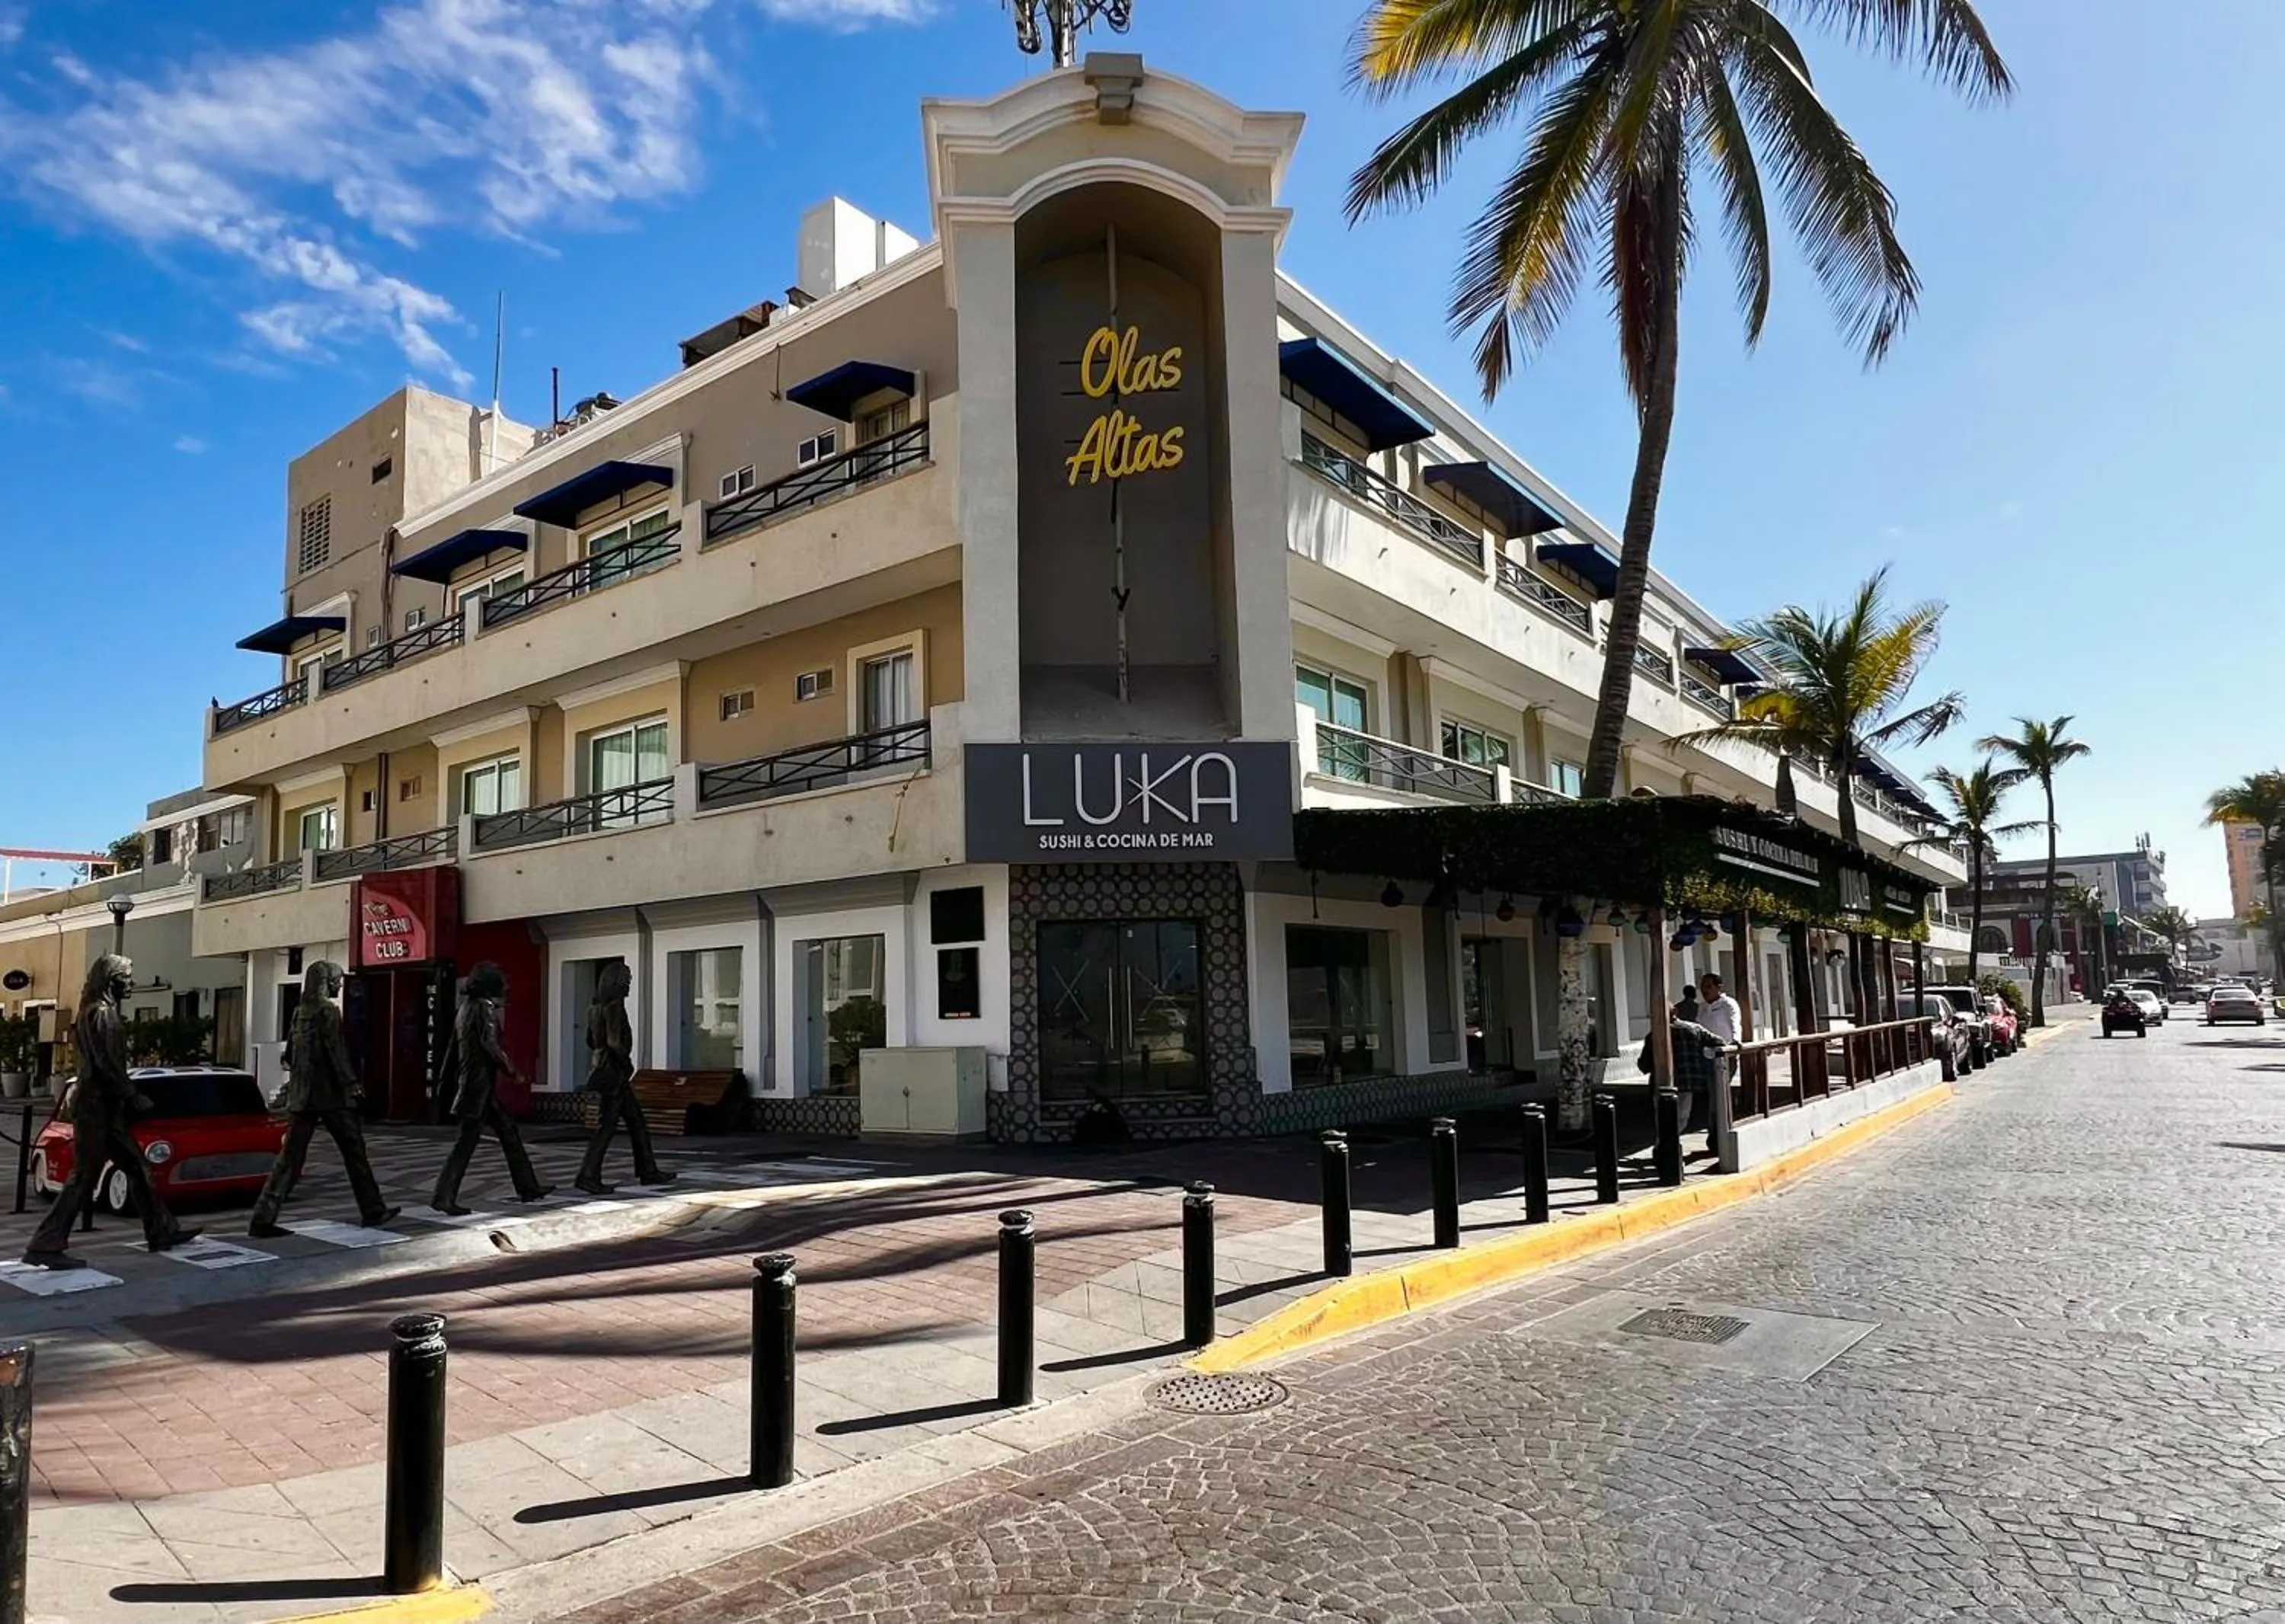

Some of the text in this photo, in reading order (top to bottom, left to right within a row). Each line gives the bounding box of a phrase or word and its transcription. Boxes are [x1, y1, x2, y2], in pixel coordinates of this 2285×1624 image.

[1081, 325, 1183, 398] Olas
[1066, 410, 1185, 487] Altas
[1023, 753, 1238, 825] LUKA
[1039, 833, 1213, 849] SUSHI & COCINA DE MAR
[364, 916, 411, 937] CAVERN
[375, 941, 404, 958] CLUB
[426, 996, 435, 1099] CAVERN
